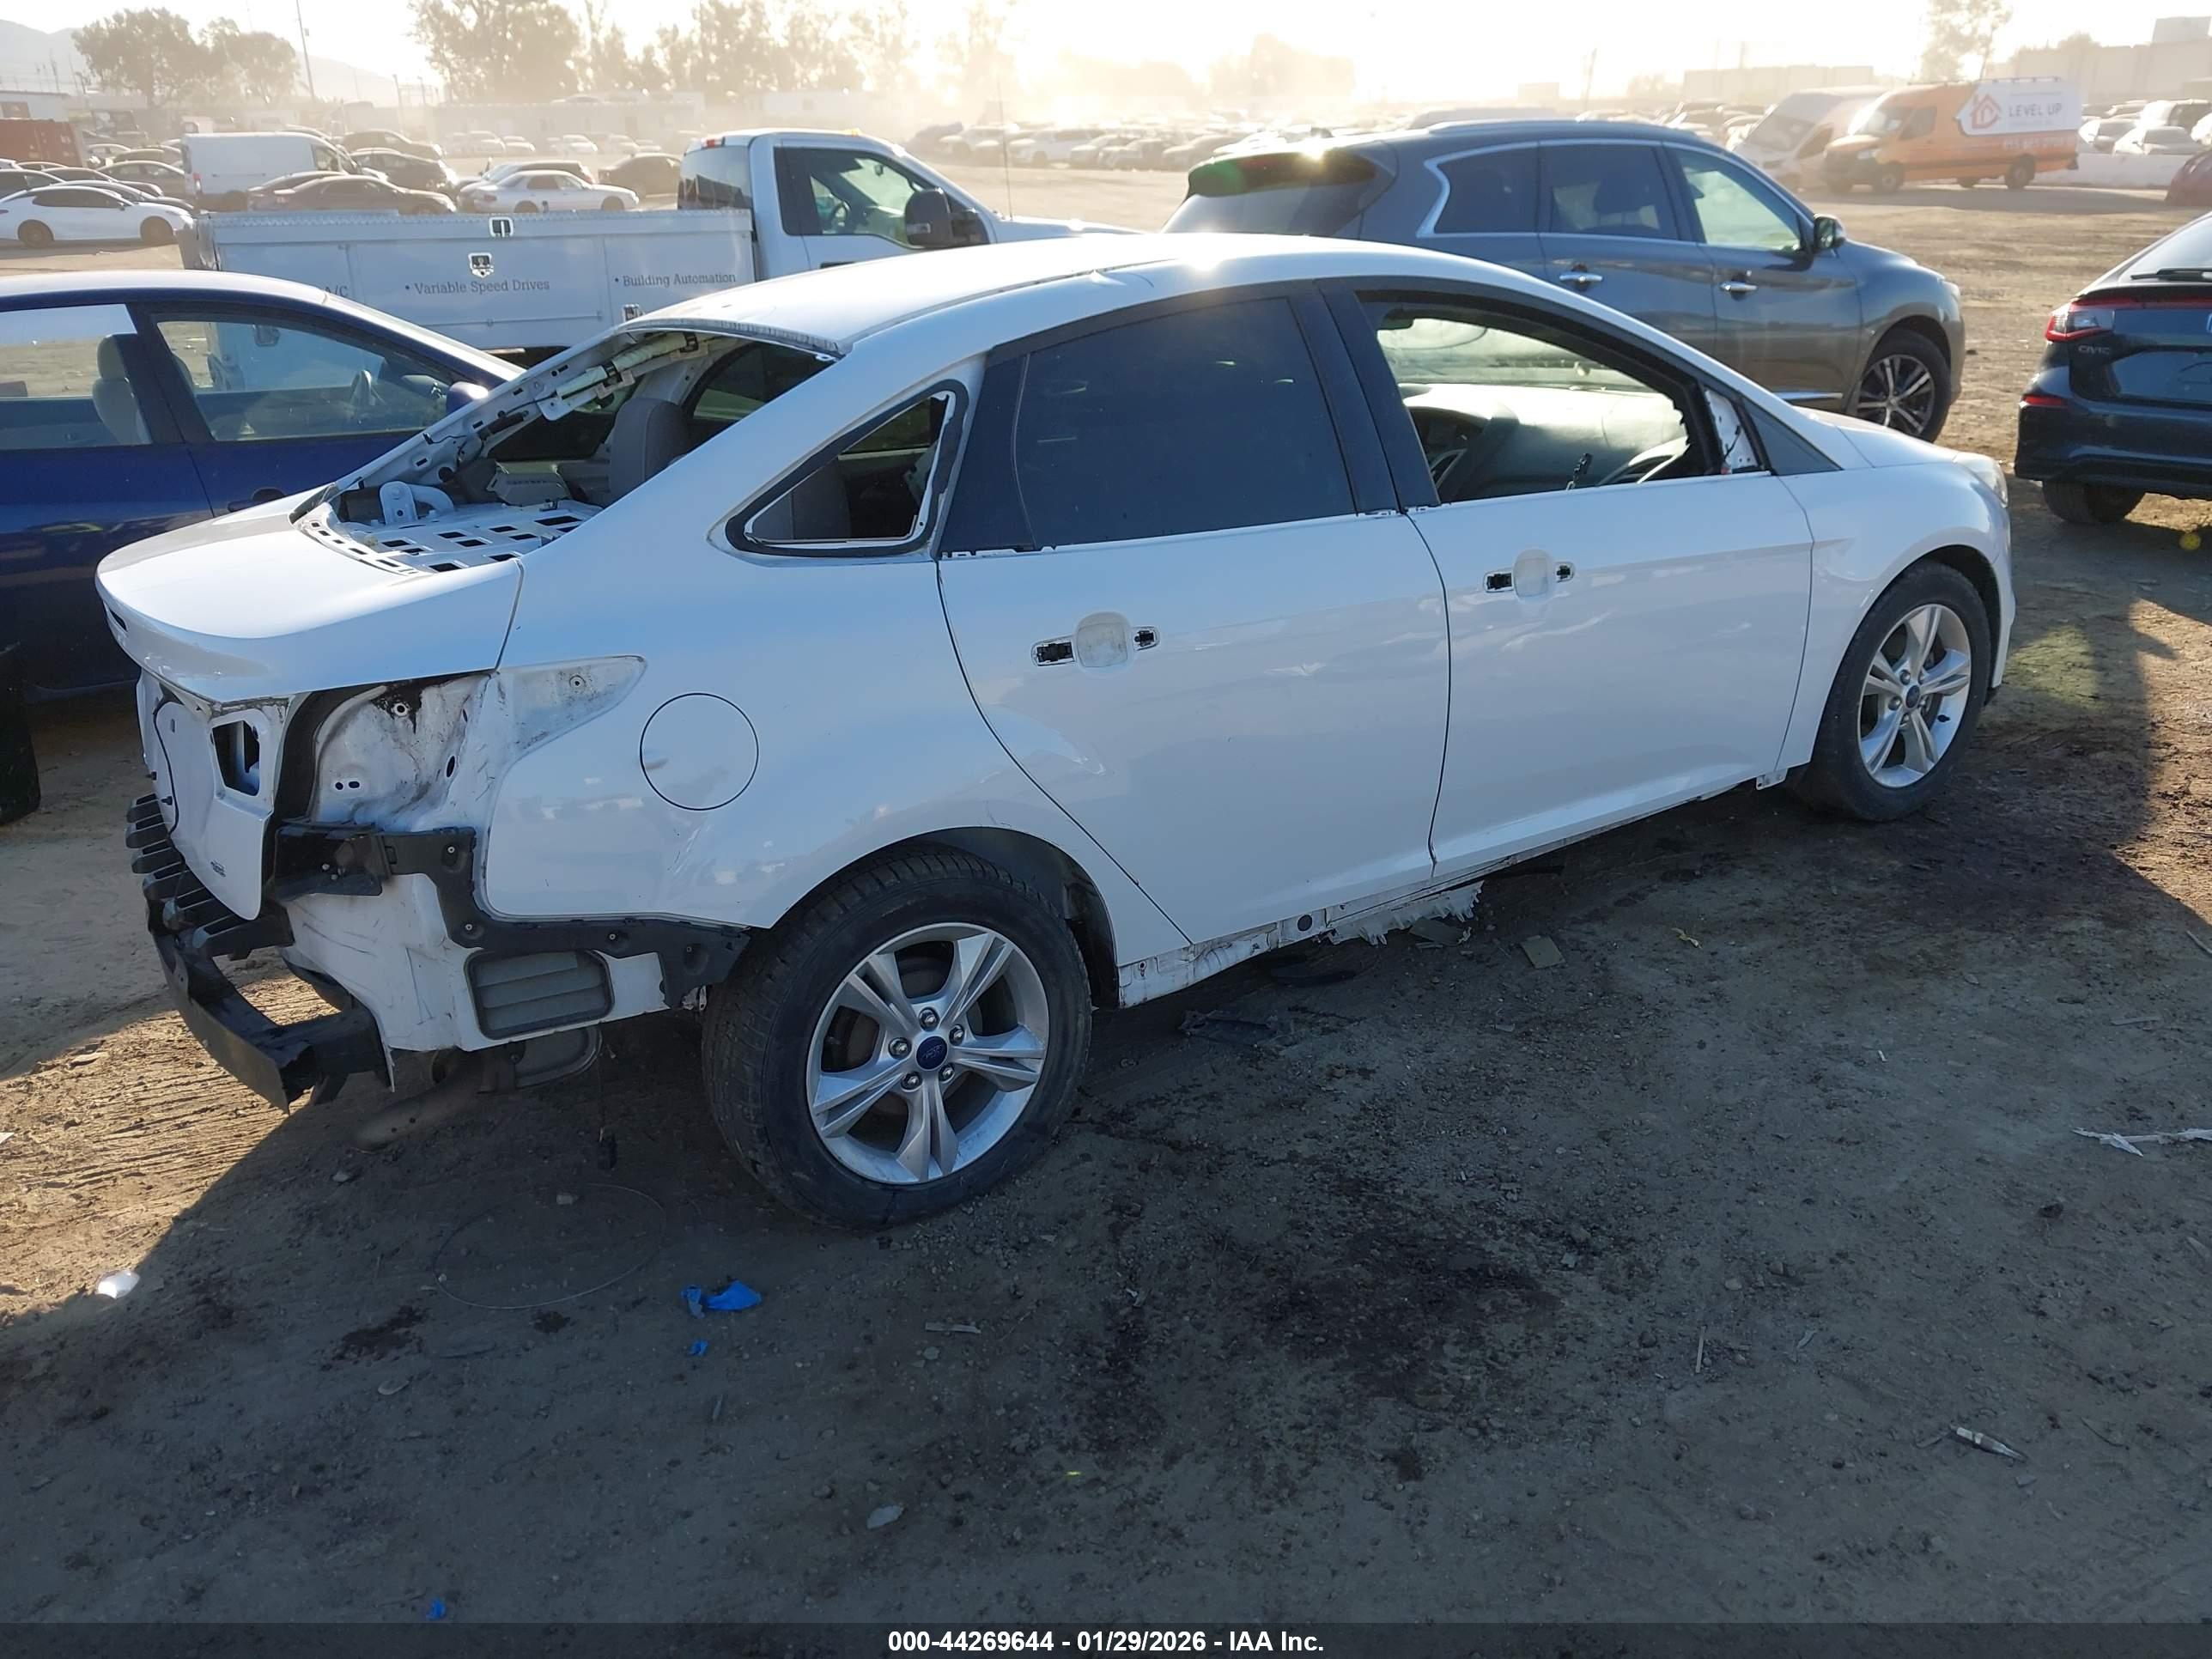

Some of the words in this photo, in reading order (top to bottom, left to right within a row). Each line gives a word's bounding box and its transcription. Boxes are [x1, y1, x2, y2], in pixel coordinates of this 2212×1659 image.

[2008, 103, 2044, 117] LEVEL
[2047, 102, 2063, 115] UP
[414, 281, 467, 295] Variable
[471, 280, 509, 295] Speed
[512, 279, 550, 291] Drives
[623, 275, 670, 288] Building
[673, 272, 737, 285] Automation
